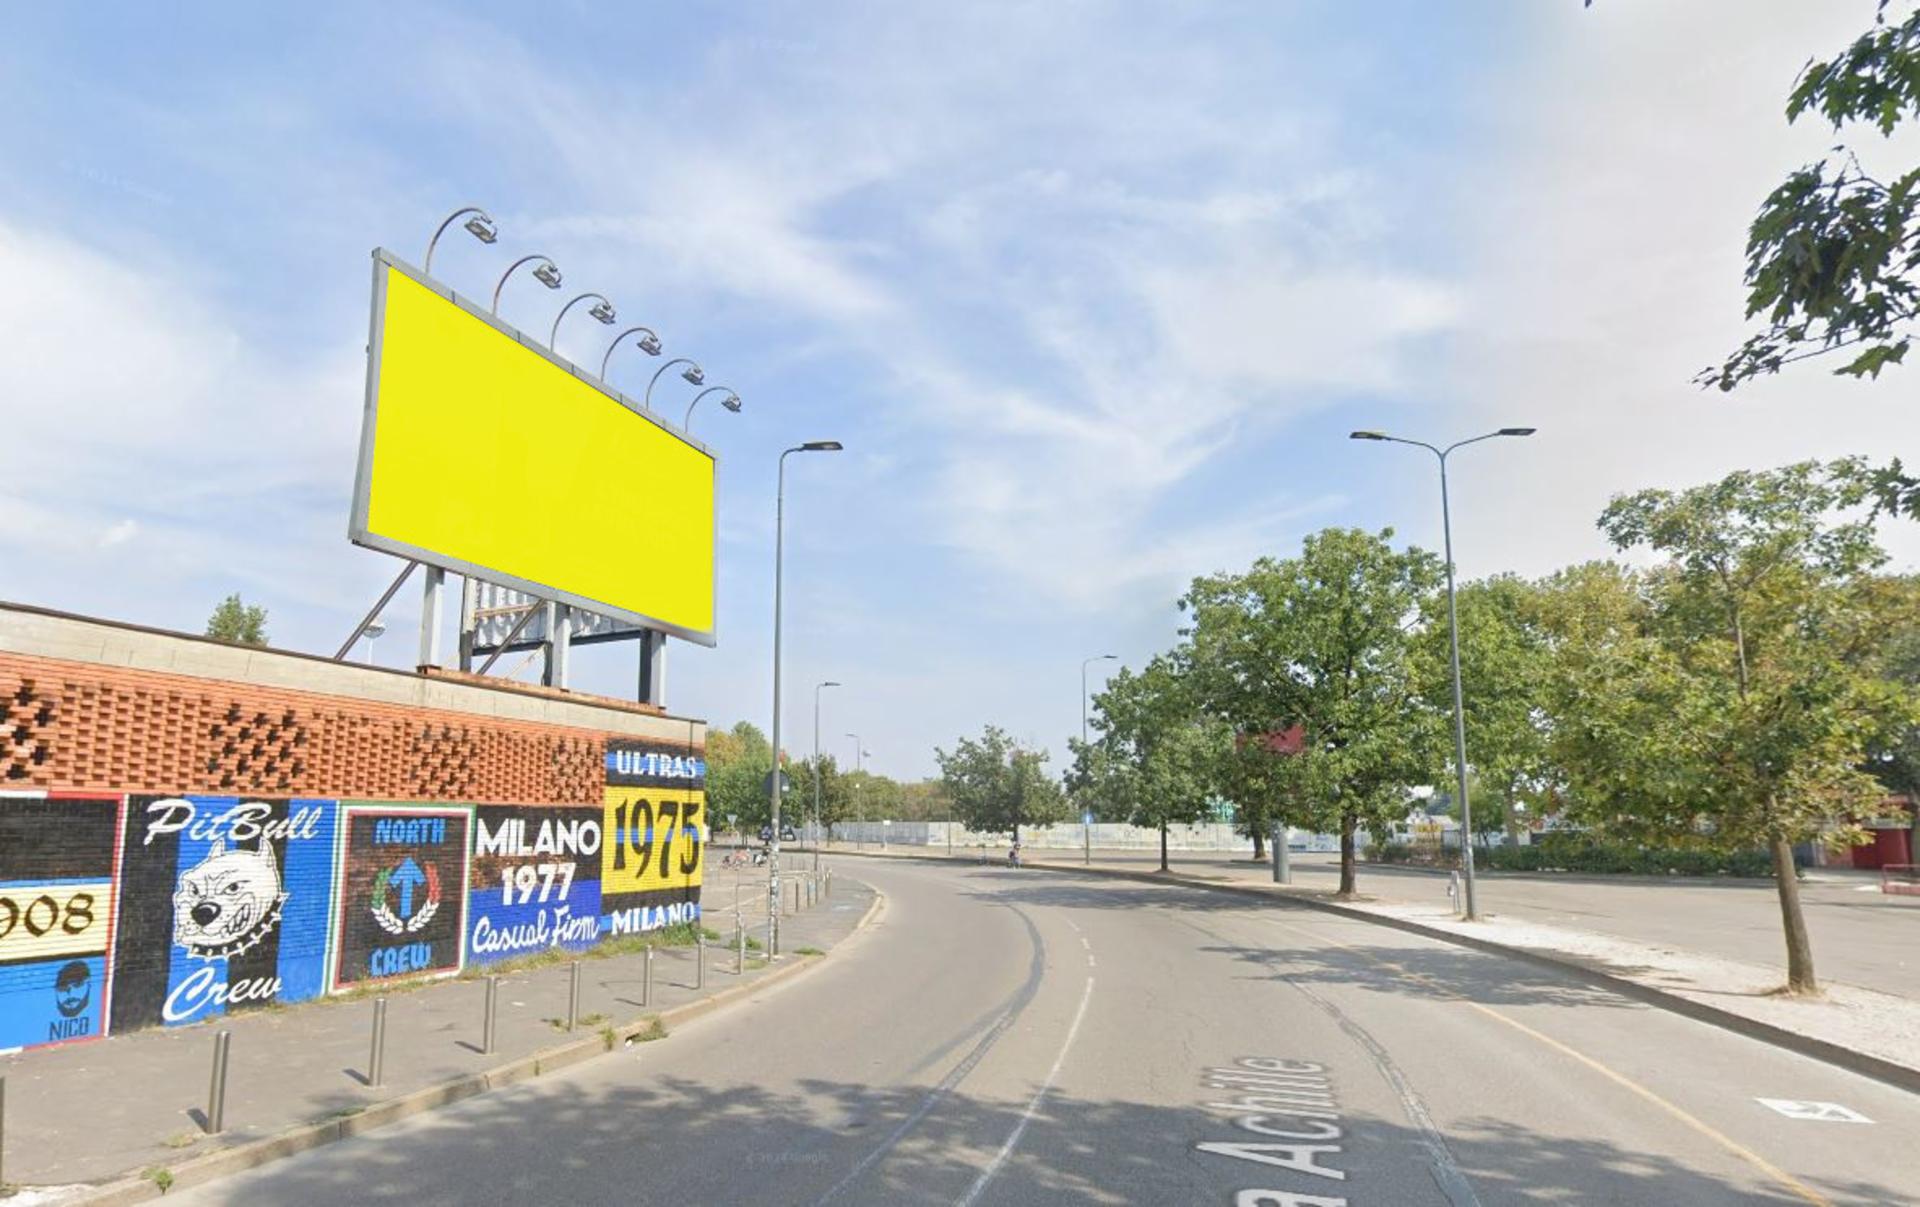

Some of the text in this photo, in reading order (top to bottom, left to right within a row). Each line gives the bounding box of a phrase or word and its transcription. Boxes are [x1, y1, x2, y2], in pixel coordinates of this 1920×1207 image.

[616, 750, 697, 778] ULTRAS
[374, 818, 447, 845] NORTH
[477, 819, 602, 857] MILANO
[613, 798, 700, 879] 1975
[502, 862, 577, 906] 1977
[472, 905, 601, 953] Casual Firm
[611, 901, 695, 936] MILANO
[371, 941, 432, 978] CREW
[162, 967, 283, 1021] Crew
[50, 1017, 90, 1041] NICO
